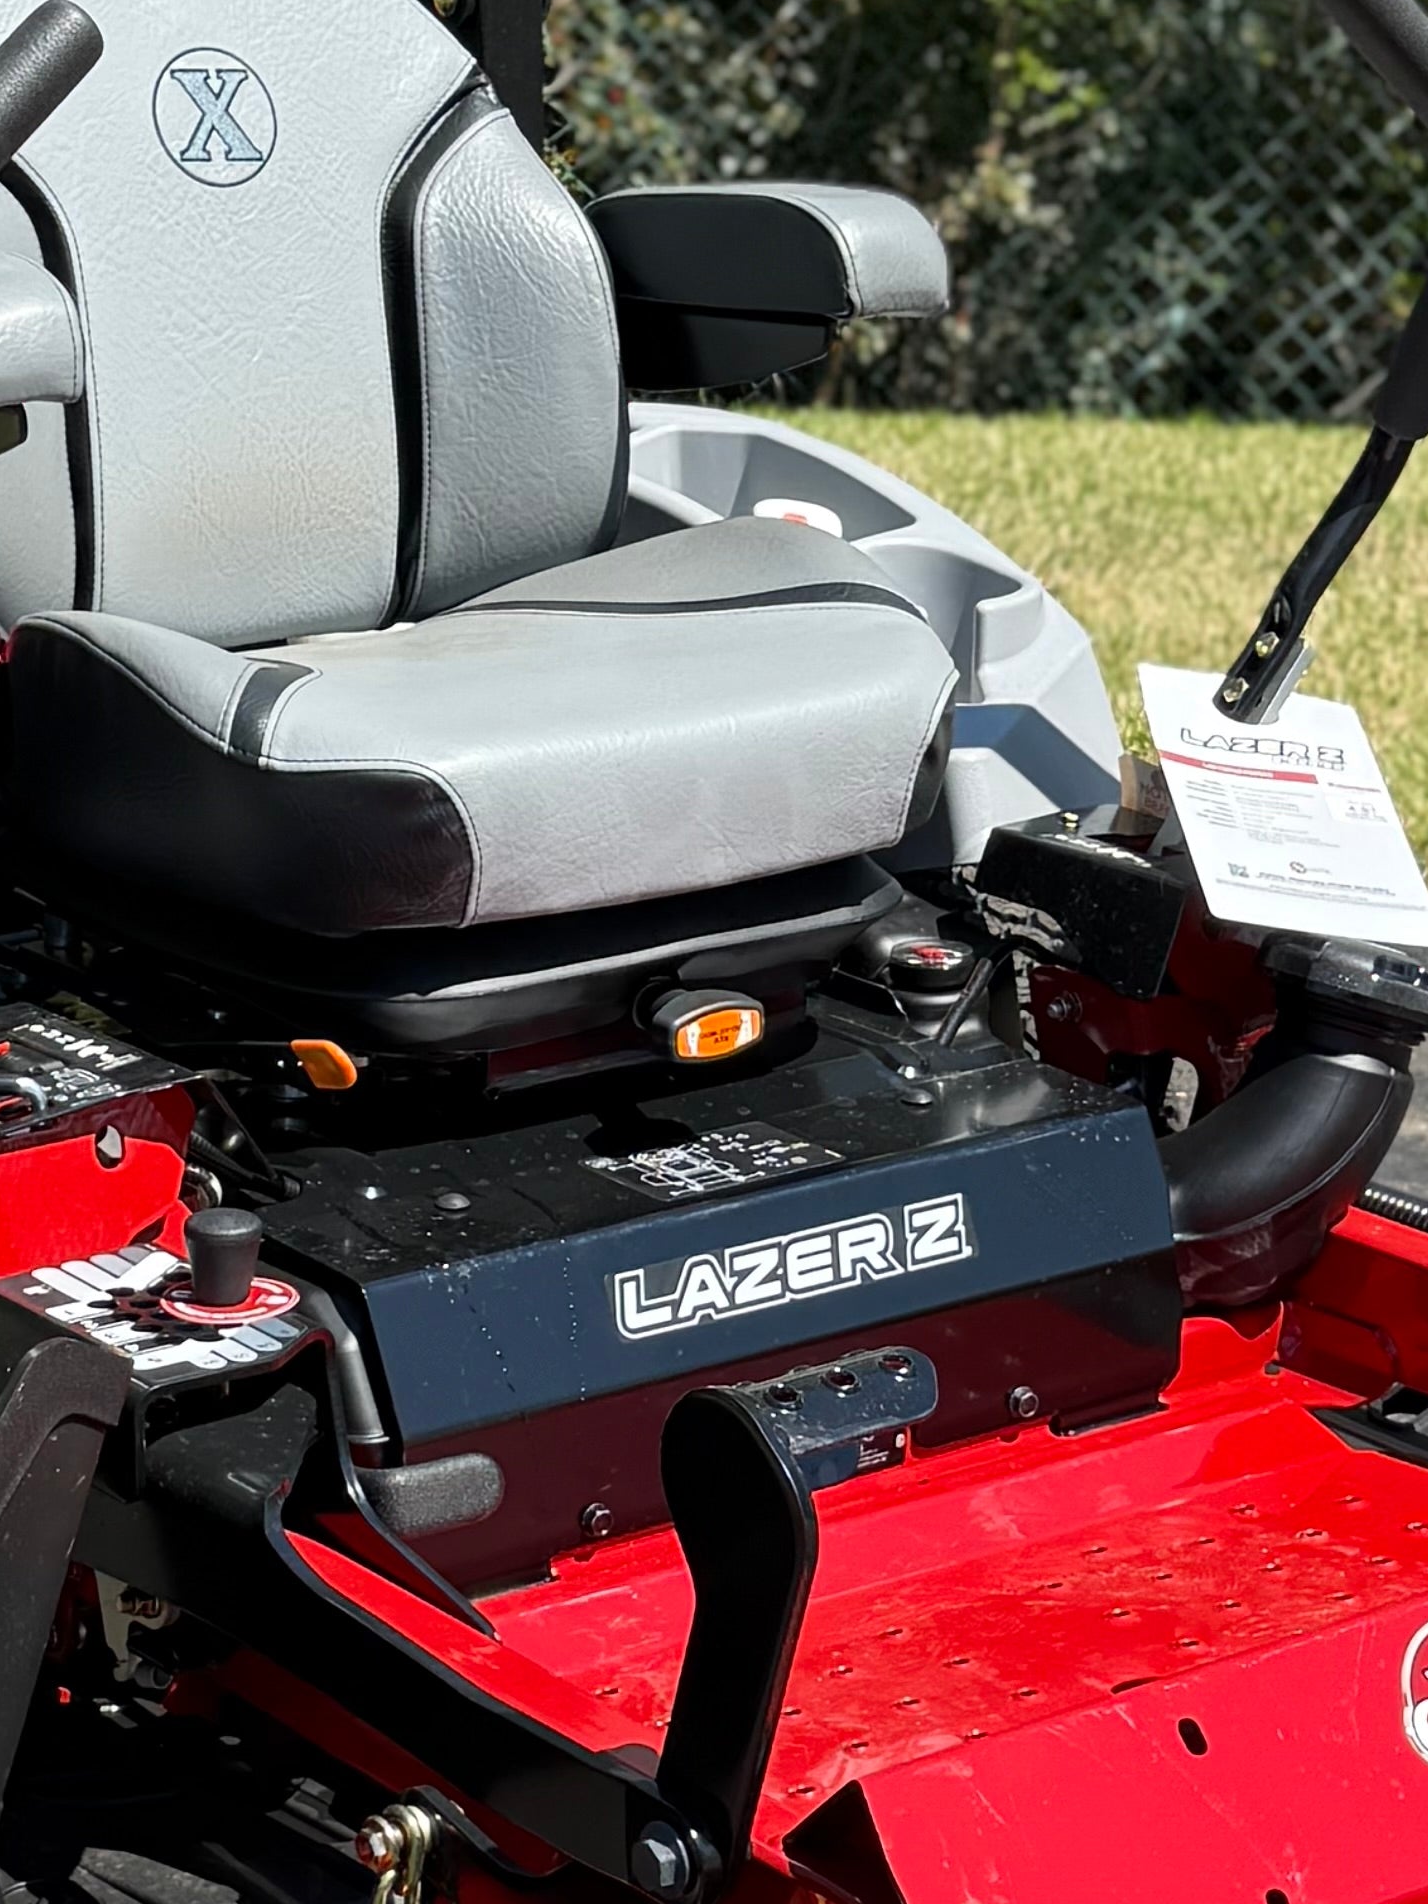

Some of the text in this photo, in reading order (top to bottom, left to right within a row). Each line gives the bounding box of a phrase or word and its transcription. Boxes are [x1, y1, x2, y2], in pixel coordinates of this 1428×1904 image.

[169, 68, 264, 162] X
[617, 1193, 974, 1340] LAZER Z
